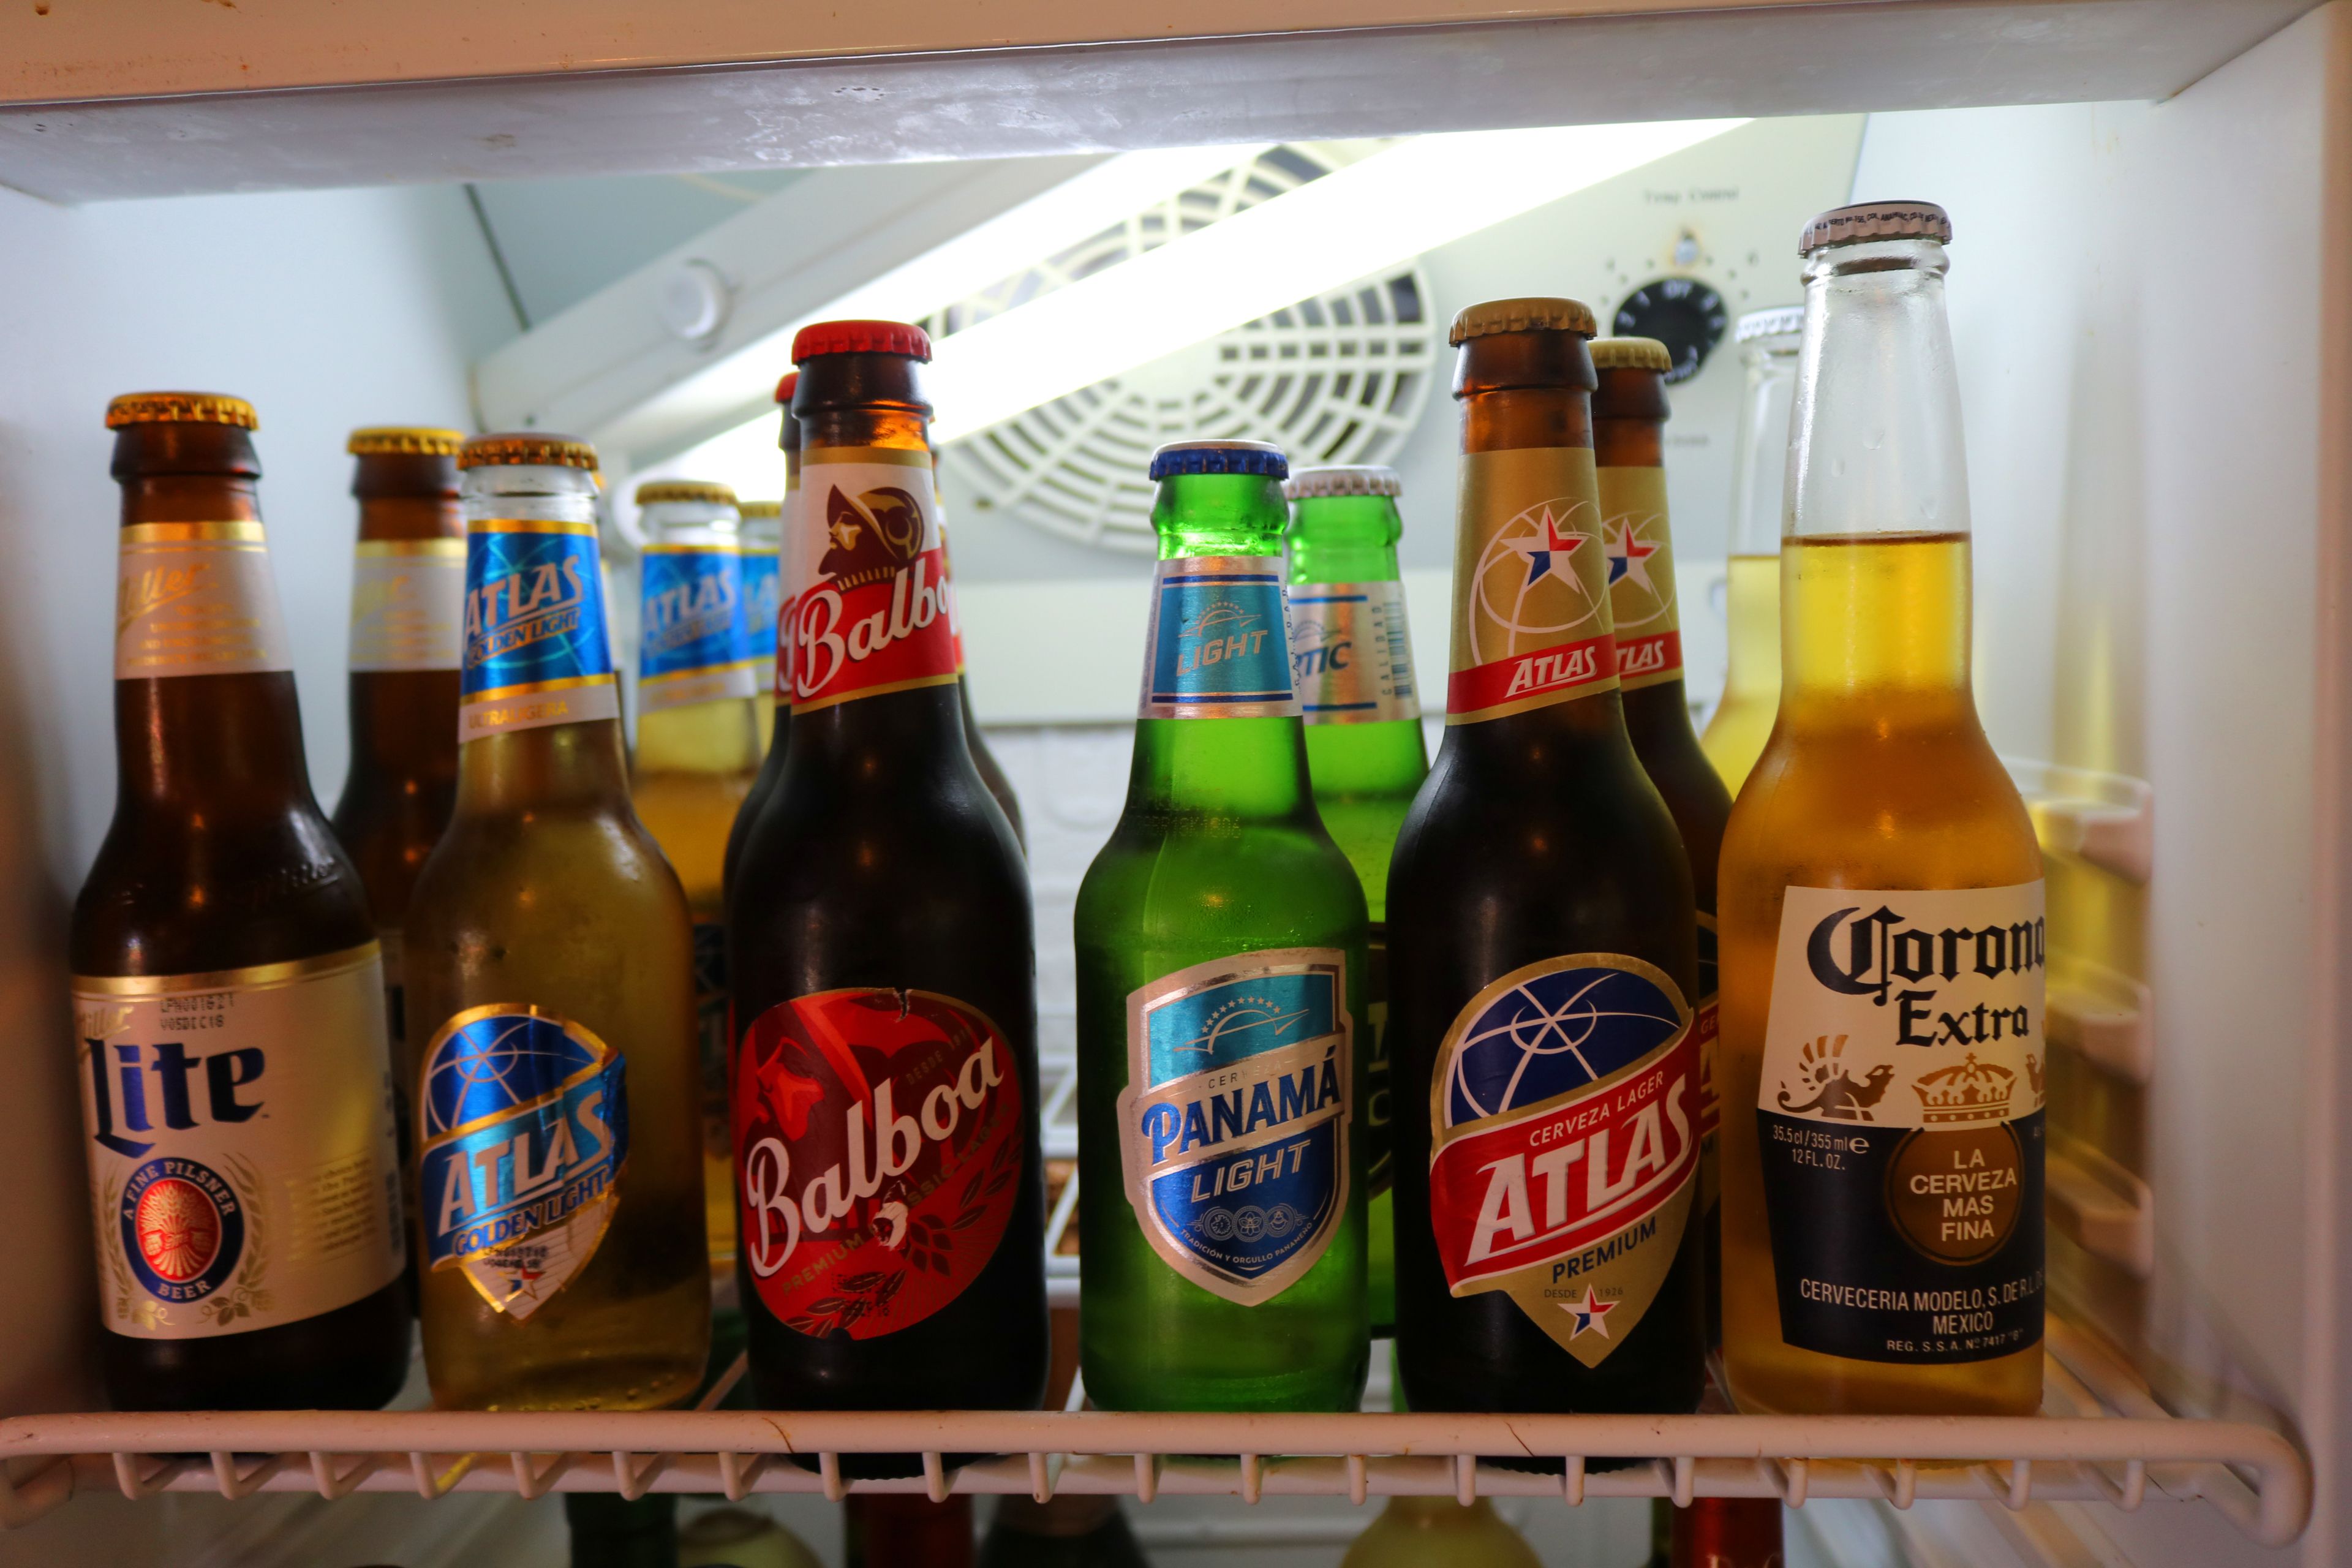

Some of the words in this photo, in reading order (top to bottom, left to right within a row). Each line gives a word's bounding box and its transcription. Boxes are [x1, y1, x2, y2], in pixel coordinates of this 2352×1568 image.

[464, 554, 584, 639] ATLAS
[1176, 630, 1268, 677] LIGHT
[1504, 646, 1598, 698] ATLAS
[1617, 641, 1665, 675] TLAS
[469, 698, 569, 729] ULTRALIGERA
[1894, 990, 2029, 1047] Extra
[84, 1038, 265, 1159] Lite
[1141, 1044, 1341, 1167] PANAMÁ
[1529, 1102, 1611, 1147] CERVEZA
[1616, 1070, 1664, 1113] LAGER
[438, 1090, 611, 1237] ATLAS
[747, 1036, 1005, 1277] Balboa
[1190, 1139, 1312, 1204] LIGHT
[1463, 1073, 1693, 1267] ATLAS
[1792, 1147, 1804, 1164] 12
[1954, 1148, 1986, 1170] LA
[126, 1165, 160, 1203] FINE
[163, 1161, 236, 1216] PILSNER
[1910, 1167, 2018, 1195] CERVEZA
[123, 1208, 134, 1221] A
[453, 1202, 541, 1257] GOLDEN
[543, 1163, 610, 1225] LIGHT
[1942, 1195, 1994, 1218] MAS
[1180, 1228, 1223, 1261] TRADICIÓN
[1232, 1253, 1274, 1264] ORGULLO
[1275, 1222, 1313, 1257] PANAMEÑO
[1551, 1215, 1656, 1284] PREMIUM
[1941, 1219, 1995, 1242] FINA
[782, 1231, 865, 1297] PREMIUM
[157, 1280, 211, 1300] BEER
[1544, 1288, 1578, 1298] DESDE
[1598, 1286, 1624, 1298] 1926
[1800, 1278, 1910, 1312] CERVECERIA
[1913, 1288, 1987, 1312] MODELO,
[1988, 1286, 2002, 1306] S.
[2002, 1281, 2018, 1304] DE
[1887, 1339, 1918, 1352] REG.
[1982, 1333, 2006, 1348] 7417
[1932, 1310, 1994, 1335] MEXICO
